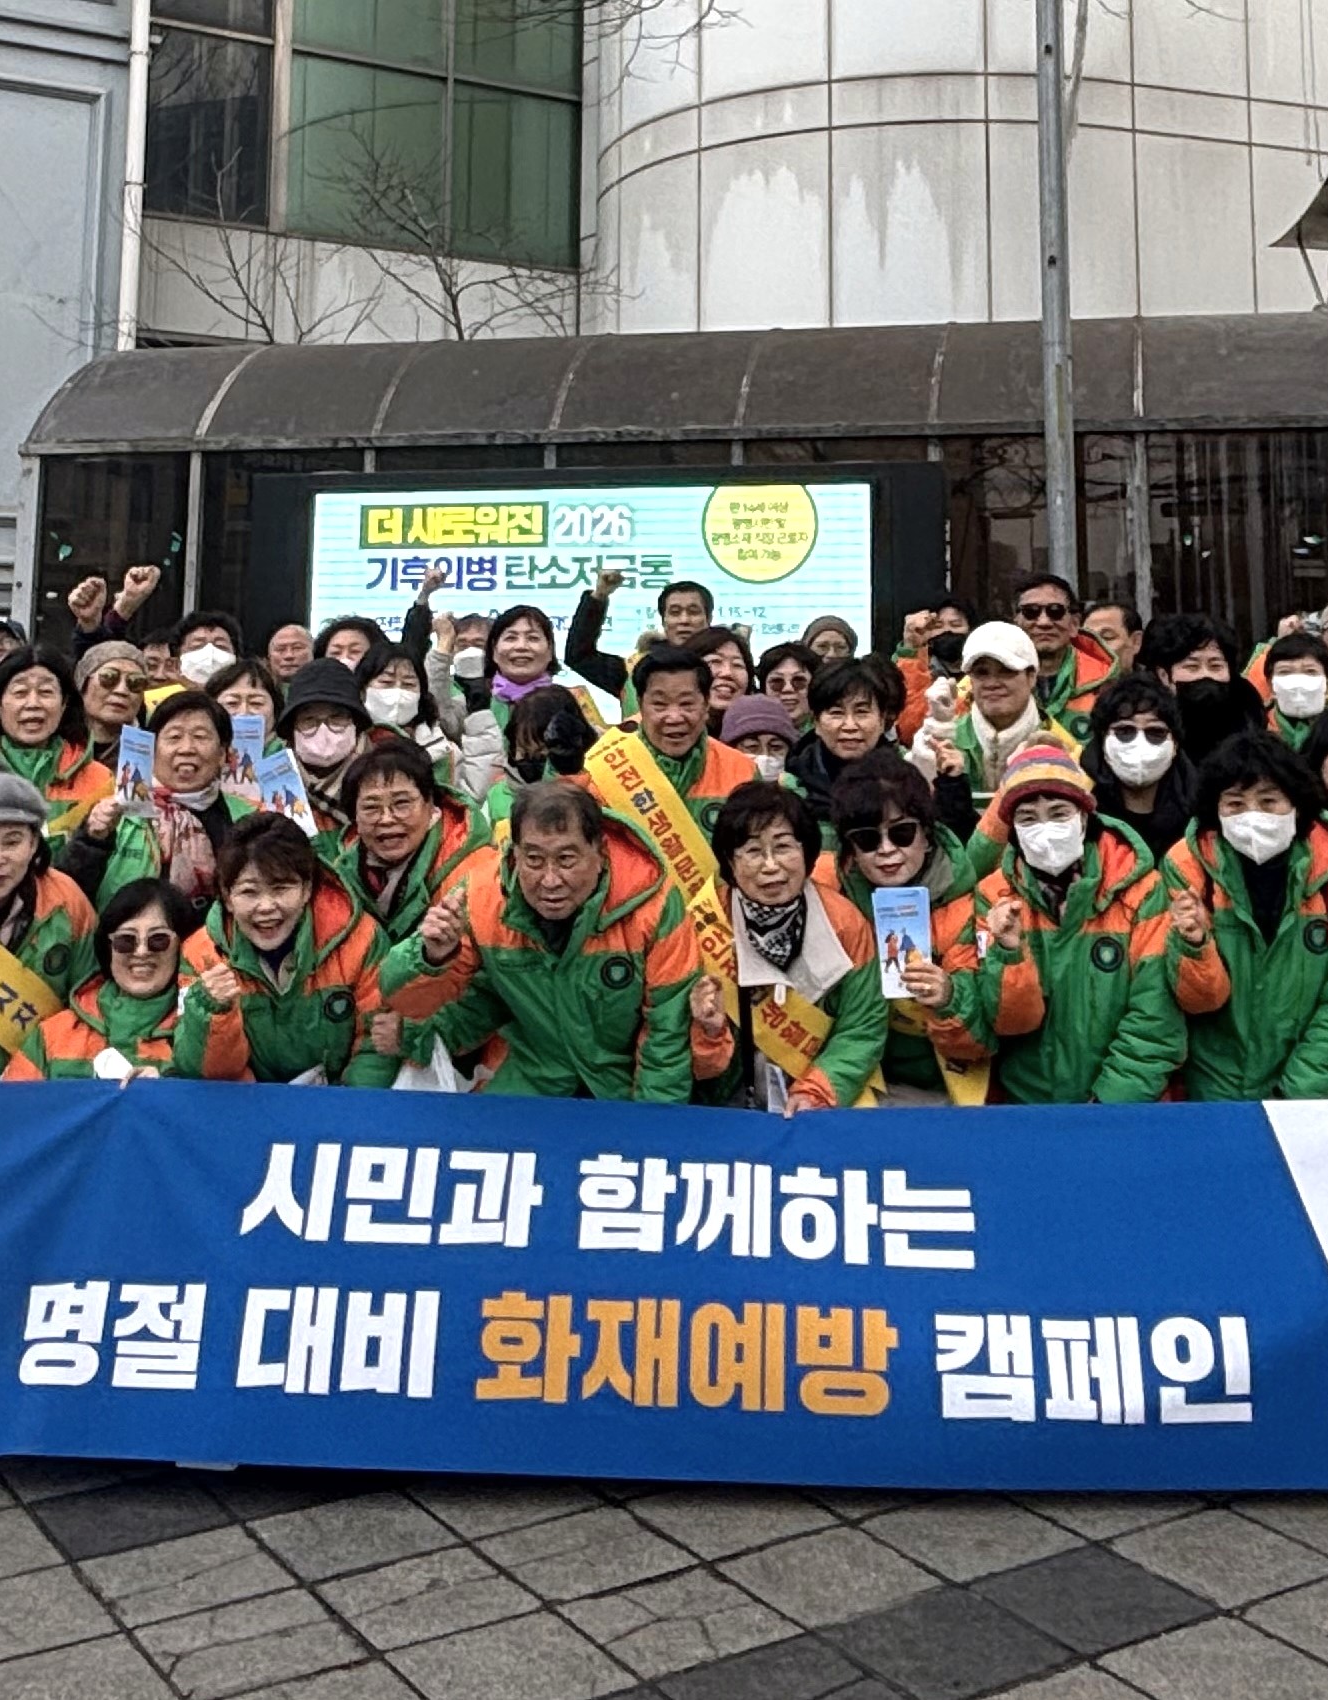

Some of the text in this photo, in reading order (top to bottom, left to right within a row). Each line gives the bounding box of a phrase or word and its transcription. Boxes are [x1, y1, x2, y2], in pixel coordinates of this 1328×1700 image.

[367, 503, 636, 546] 더 새로워진 2026
[366, 555, 498, 591] 기후의병
[240, 1144, 975, 1269] 시민과 함께하는
[20, 1281, 1252, 1423] 명절 대비 화재예방 캠페인
